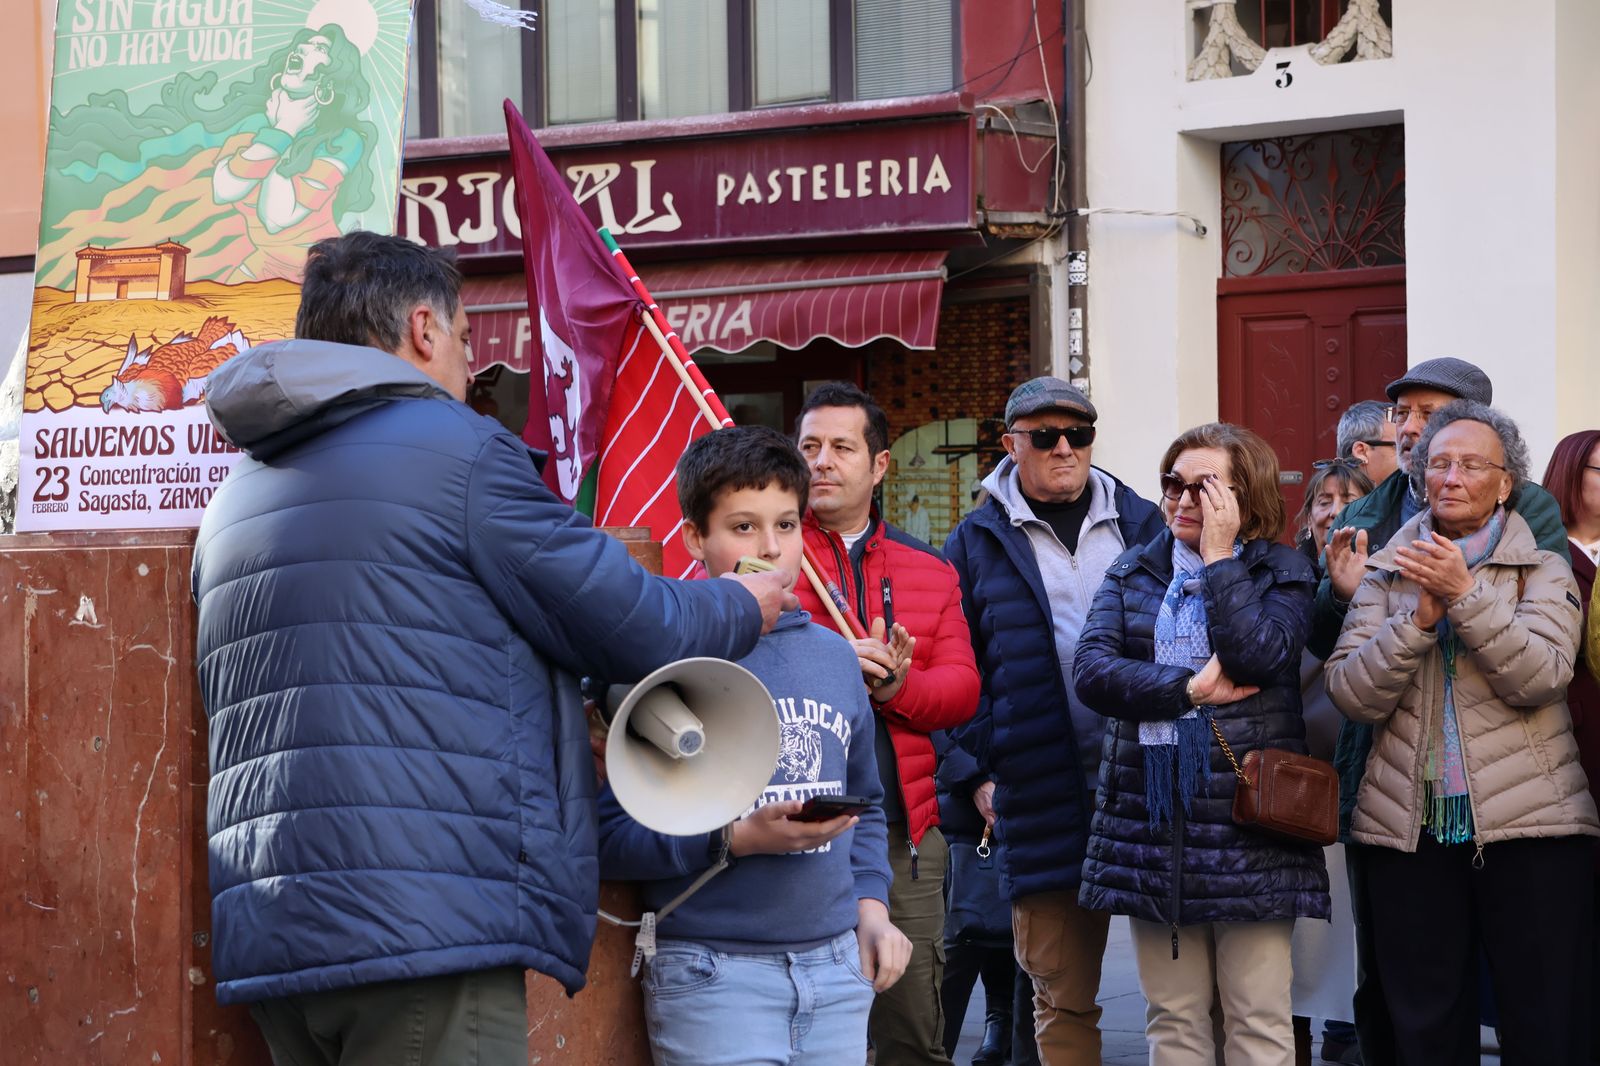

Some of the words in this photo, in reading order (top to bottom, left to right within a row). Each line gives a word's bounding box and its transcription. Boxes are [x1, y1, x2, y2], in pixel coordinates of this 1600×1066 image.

[72, 0, 134, 33] SIN
[151, 0, 254, 28] AGUA
[68, 35, 107, 69] NO
[118, 31, 177, 66] HAY
[187, 28, 254, 62] VIDA
[1274, 61, 1293, 88] 3
[716, 153, 952, 206] PASTELERIA
[35, 424, 175, 459] SALVEMOS
[187, 423, 245, 454] VIL
[32, 466, 70, 502] 23
[79, 462, 201, 486] Concentración
[208, 466, 230, 482] en
[32, 502, 69, 514] FEBRERO
[78, 489, 152, 514] Sagasta,
[159, 486, 218, 510] ZAMO
[773, 697, 852, 760] ILDCAT
